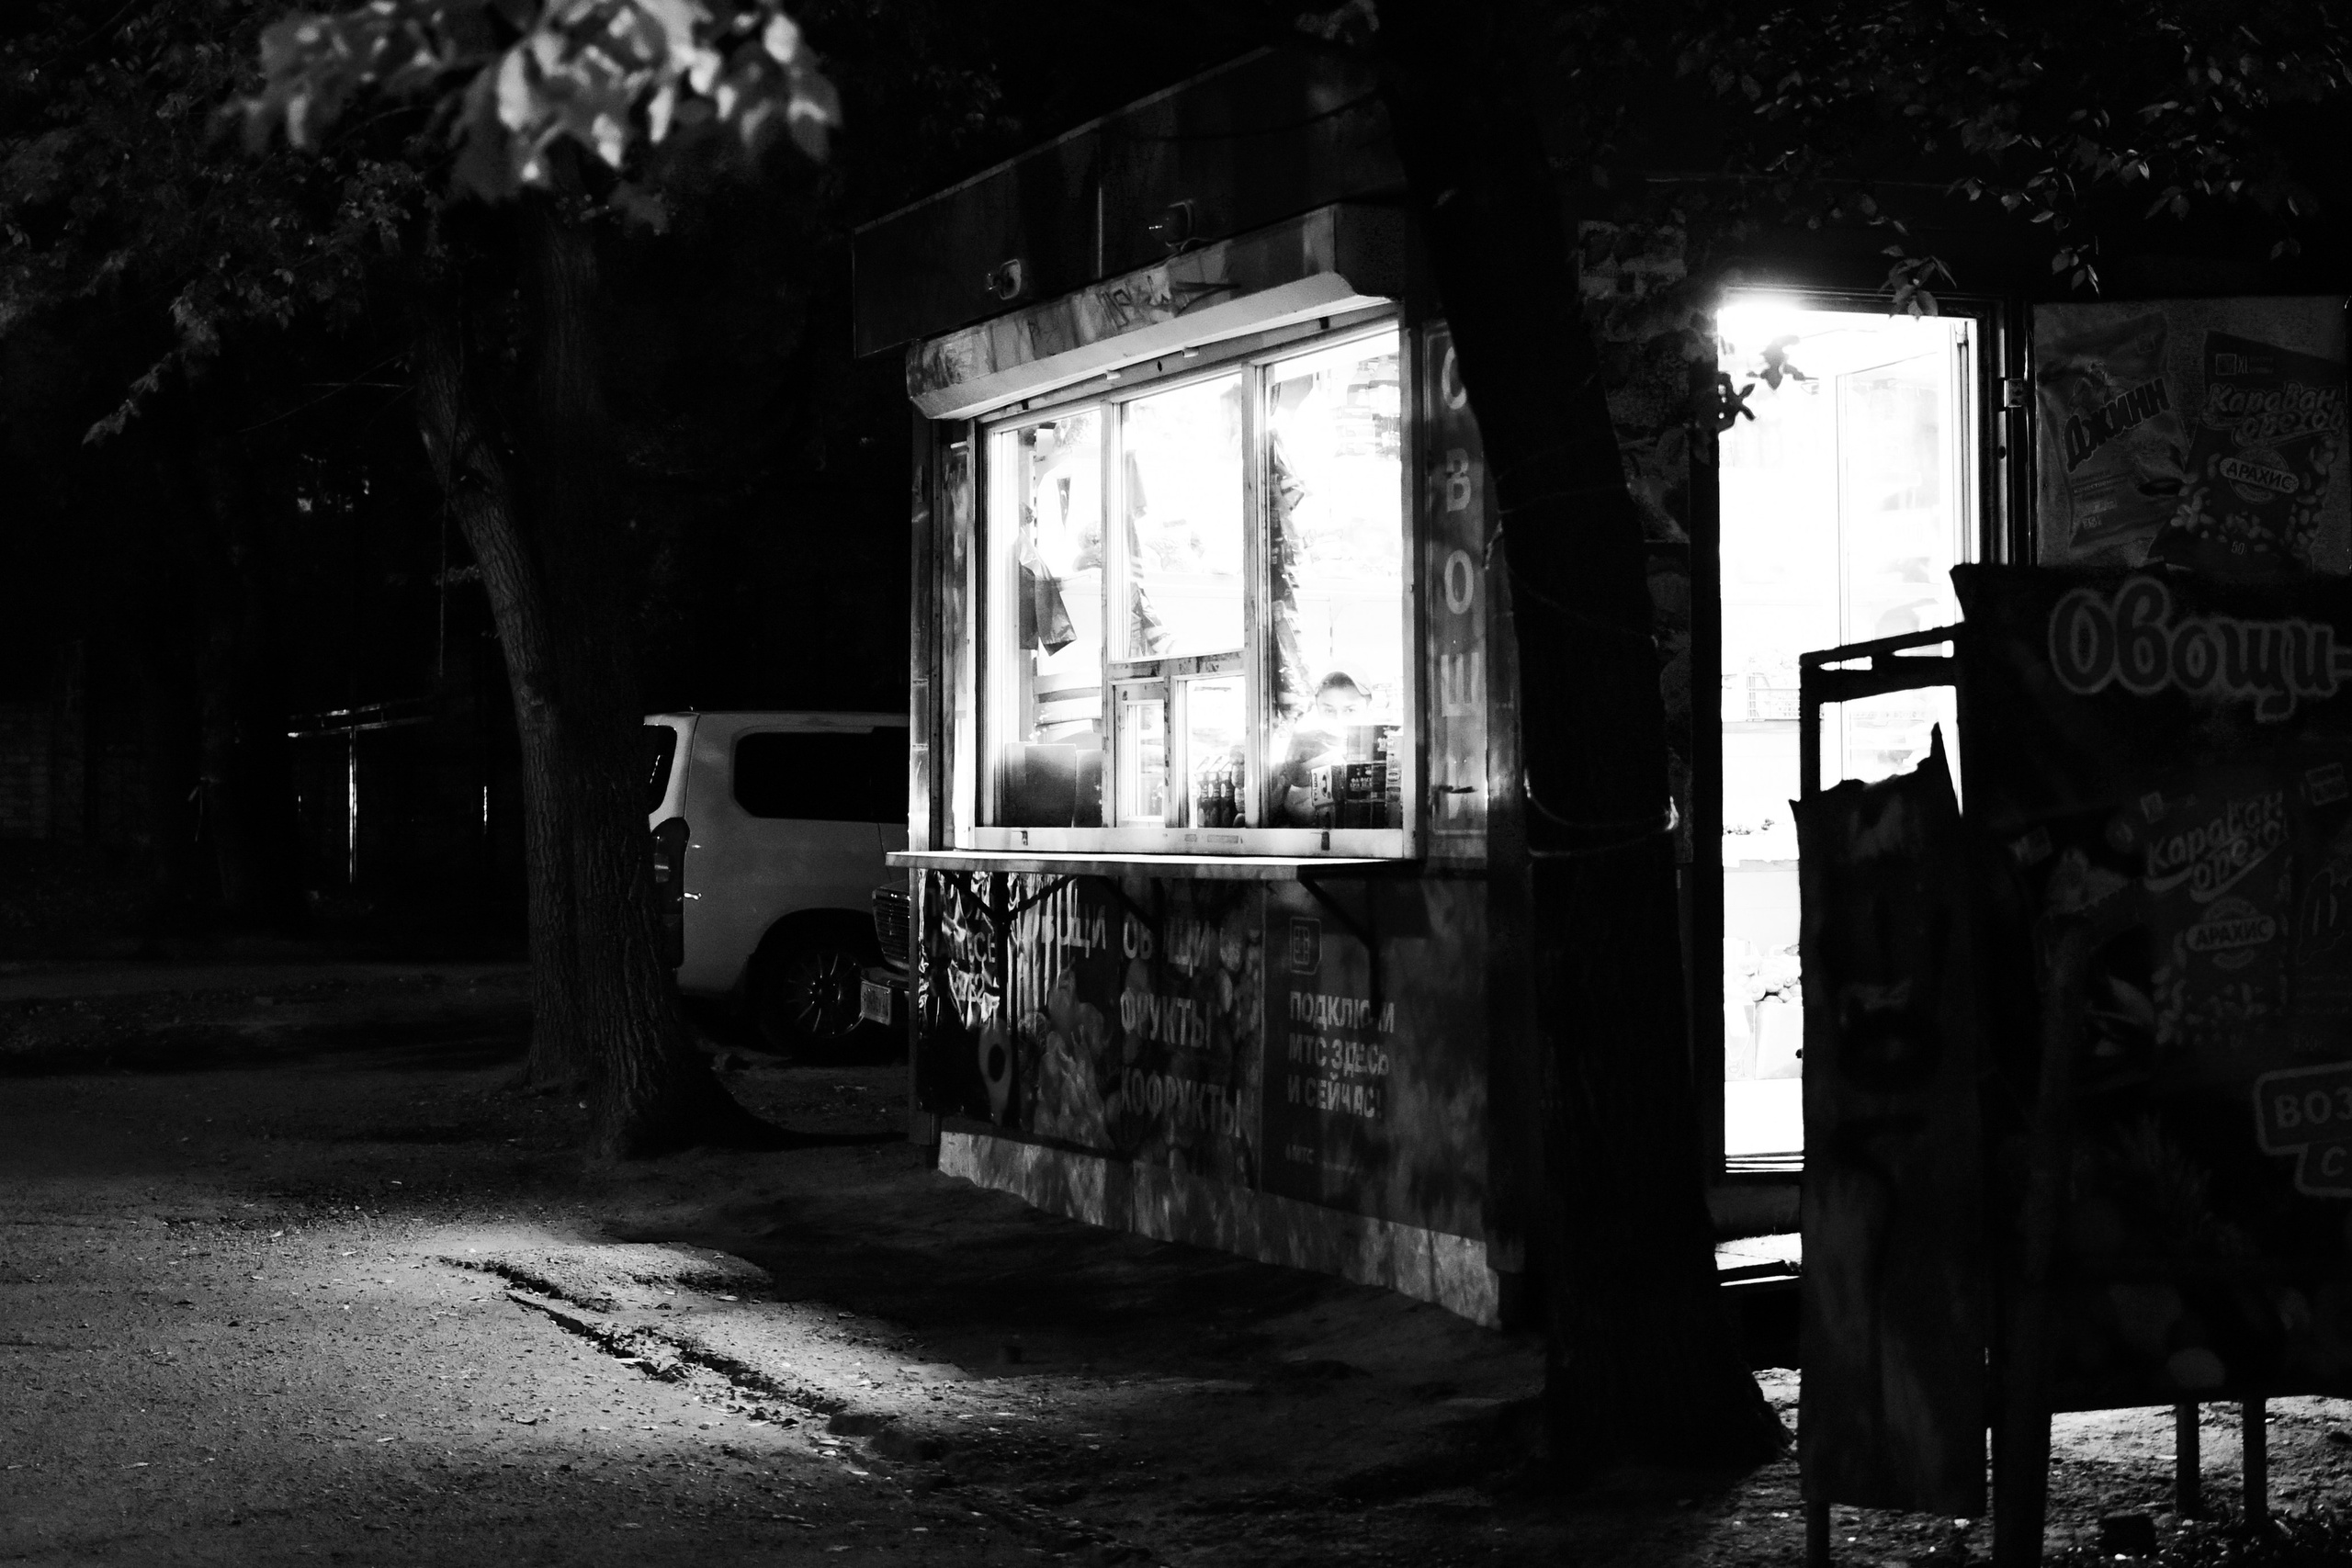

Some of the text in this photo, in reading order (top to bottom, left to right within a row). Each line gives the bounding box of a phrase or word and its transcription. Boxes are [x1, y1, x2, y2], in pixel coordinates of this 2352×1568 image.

[2226, 461, 2293, 491] АРАХИС
[1120, 987, 1213, 1050] ФРУКТЫ
[1288, 1032, 1390, 1078] МТС ЗДЕСЬ
[1287, 1074, 1301, 1105] И
